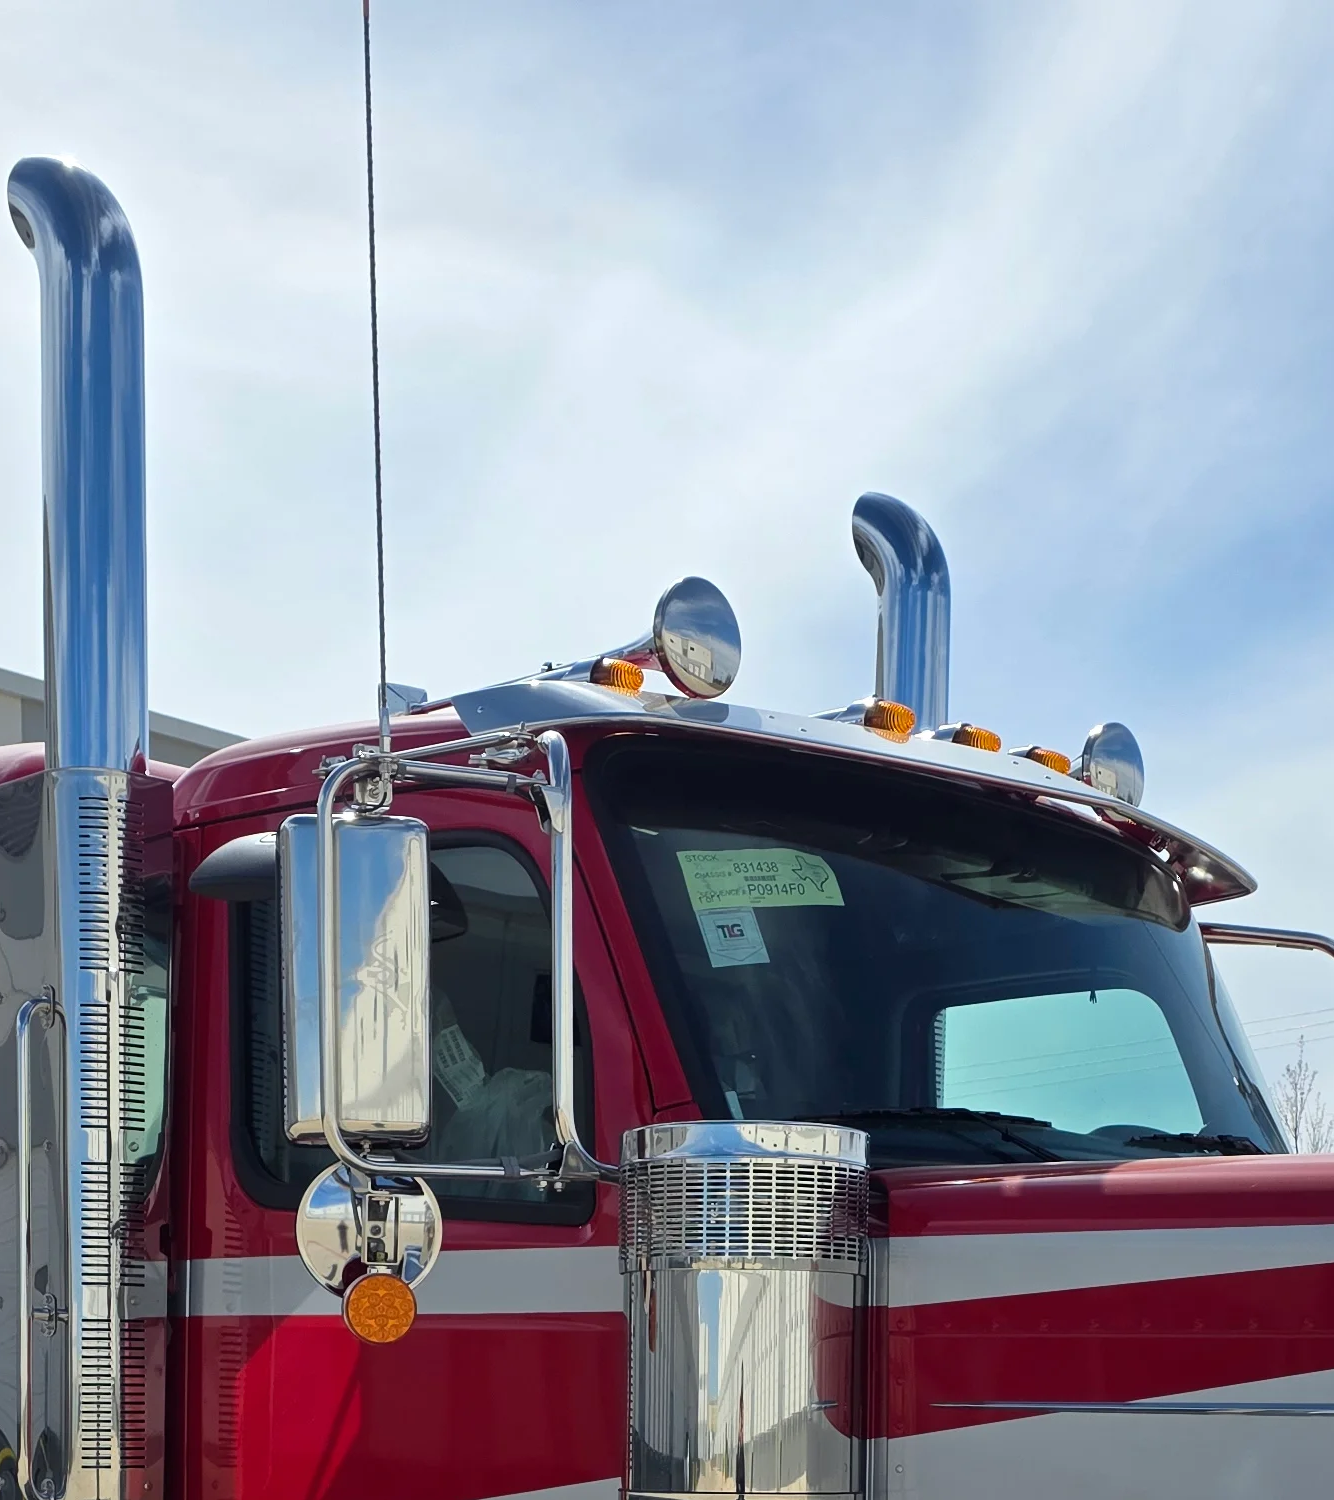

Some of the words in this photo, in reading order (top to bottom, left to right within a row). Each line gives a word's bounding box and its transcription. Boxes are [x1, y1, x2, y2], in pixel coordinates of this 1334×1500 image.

[684, 854, 719, 862] STOCK
[733, 861, 779, 873] 831438
[747, 883, 805, 896] P0914F0
[716, 923, 745, 939] TLG
